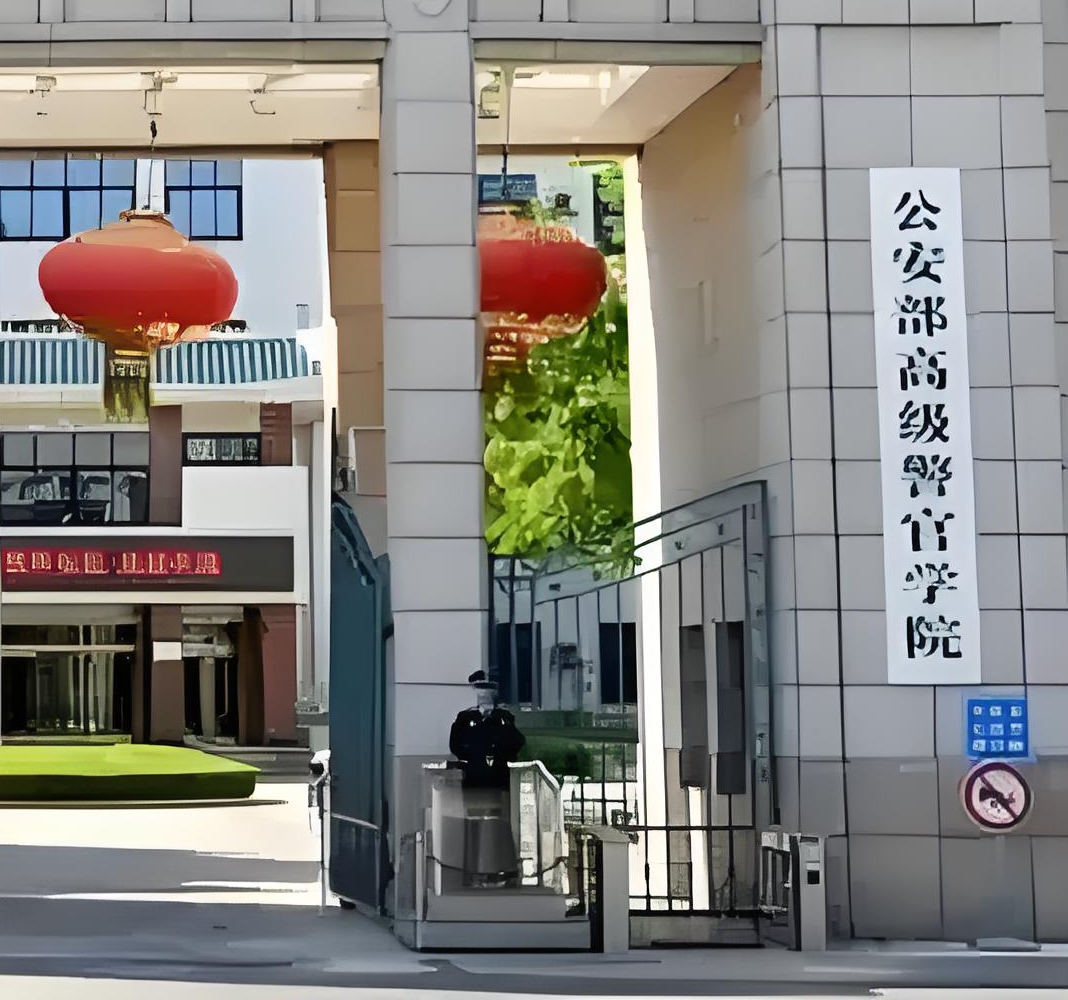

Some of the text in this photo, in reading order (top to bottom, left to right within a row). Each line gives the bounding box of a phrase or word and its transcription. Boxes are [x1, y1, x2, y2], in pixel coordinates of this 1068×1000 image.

[892, 189, 963, 659] 公安部高级警官学院
